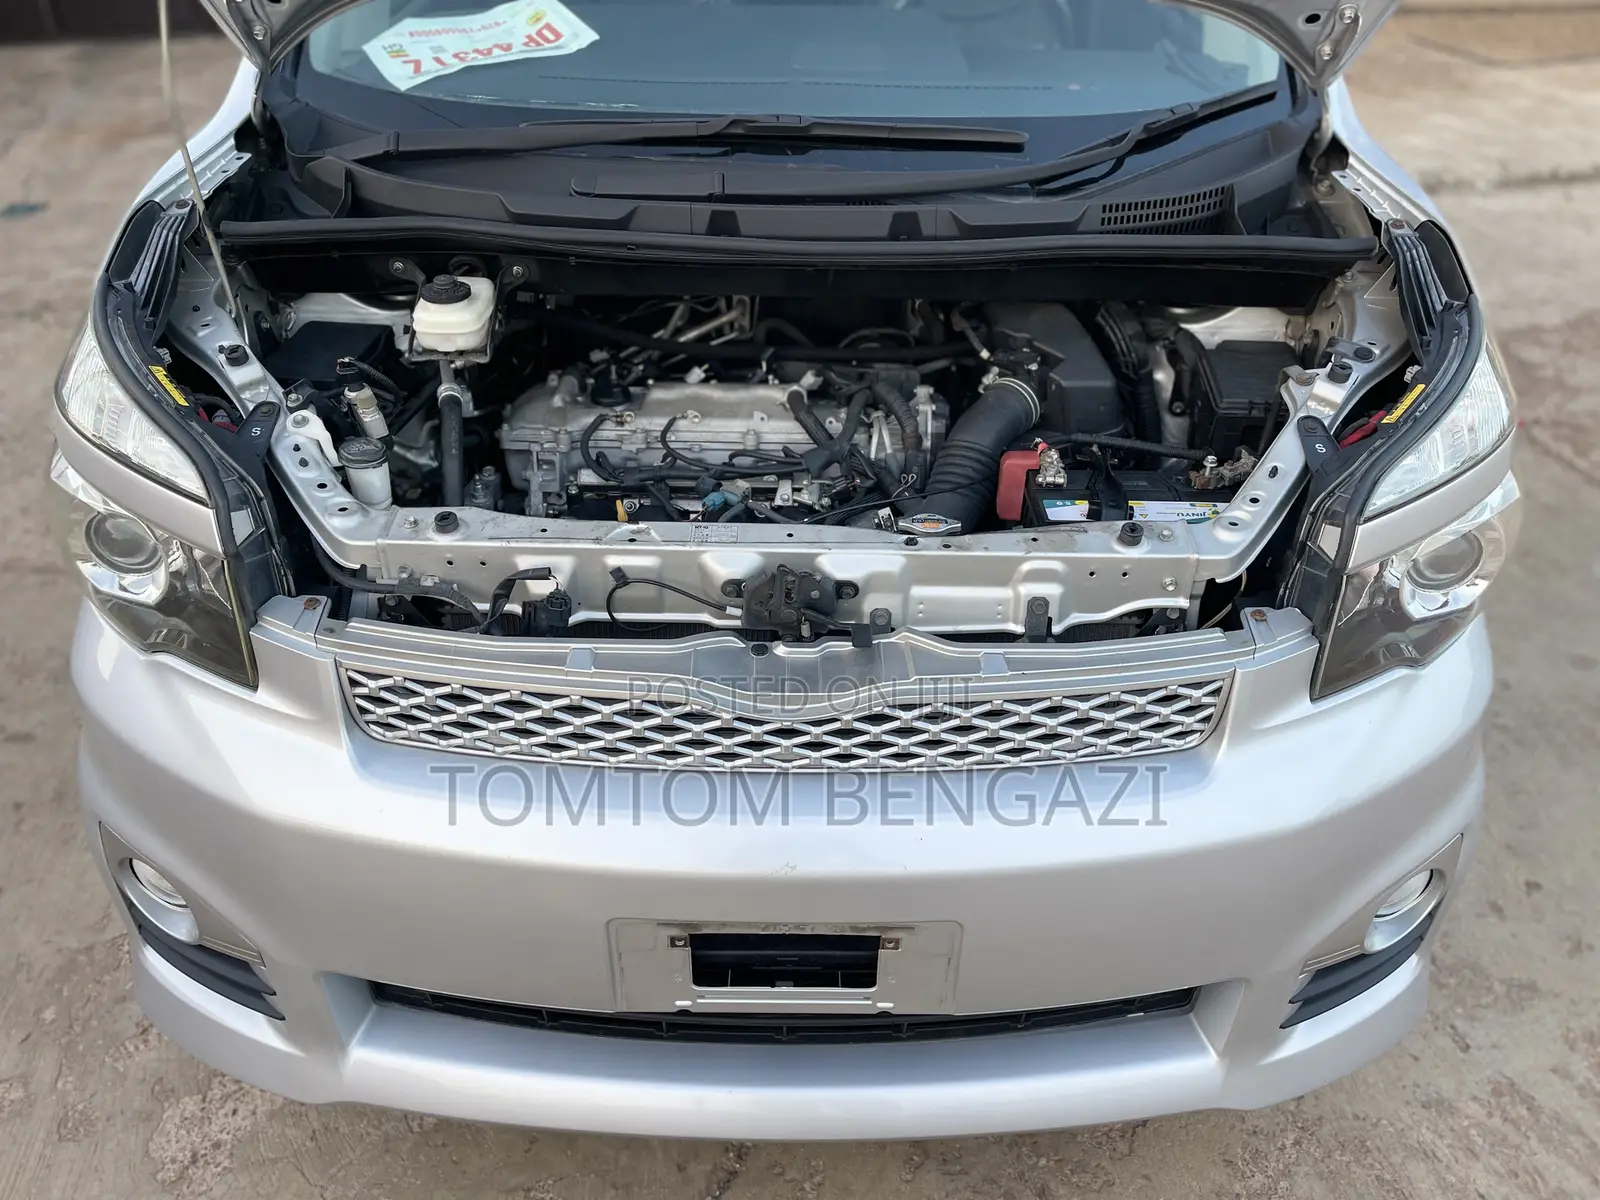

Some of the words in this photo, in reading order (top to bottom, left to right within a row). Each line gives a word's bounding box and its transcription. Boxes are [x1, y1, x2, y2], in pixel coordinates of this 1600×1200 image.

[522, 22, 564, 47] DP
[251, 427, 261, 436] S
[1315, 443, 1326, 453] S
